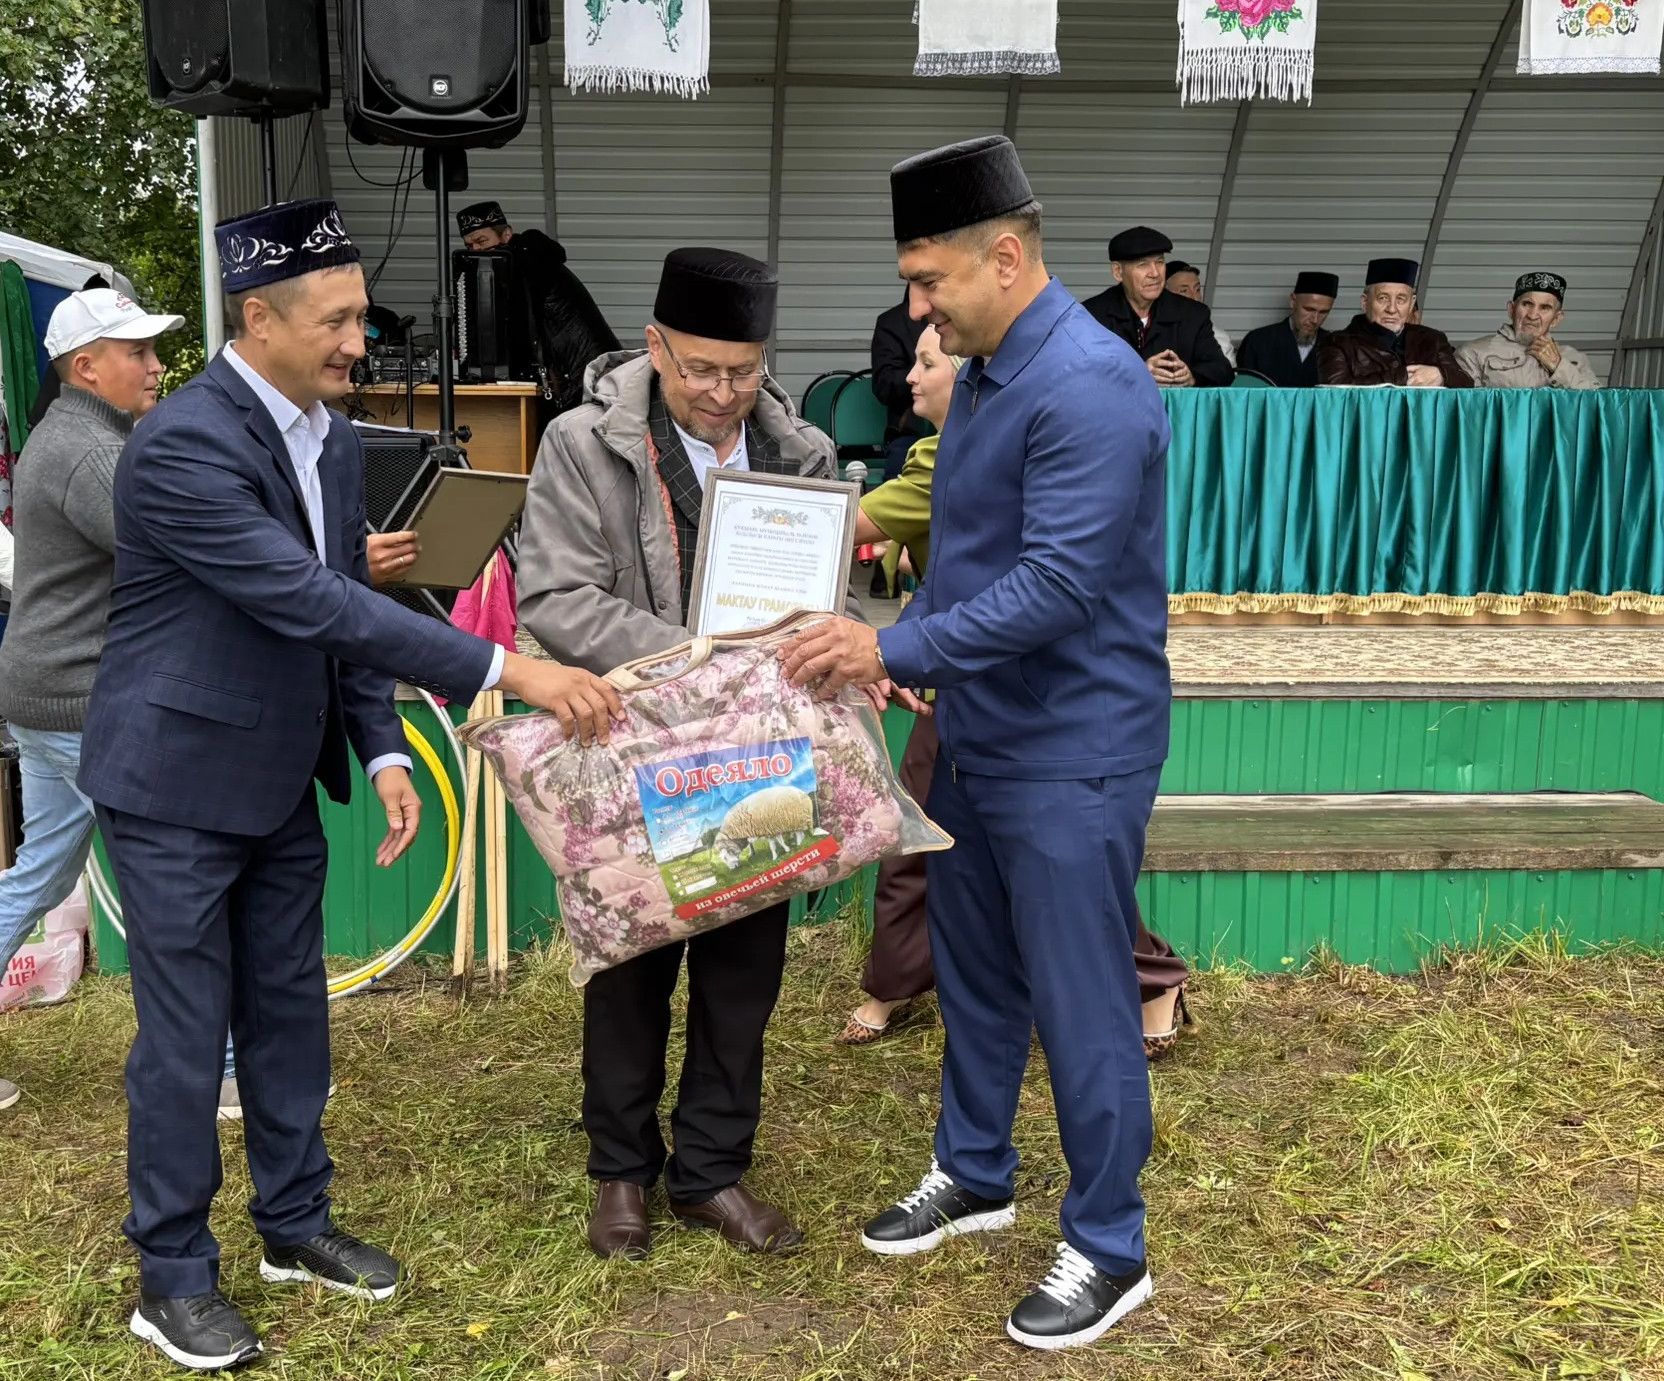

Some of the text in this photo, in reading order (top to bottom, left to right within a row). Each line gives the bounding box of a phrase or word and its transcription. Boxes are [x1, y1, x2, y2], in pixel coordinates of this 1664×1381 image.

[716, 592, 756, 609] МАКТАУ
[655, 753, 793, 797] Одеяло
[695, 900, 713, 911] из
[715, 874, 769, 904] овечьей
[771, 848, 821, 879] шерсти
[12, 956, 35, 970] ИЯ
